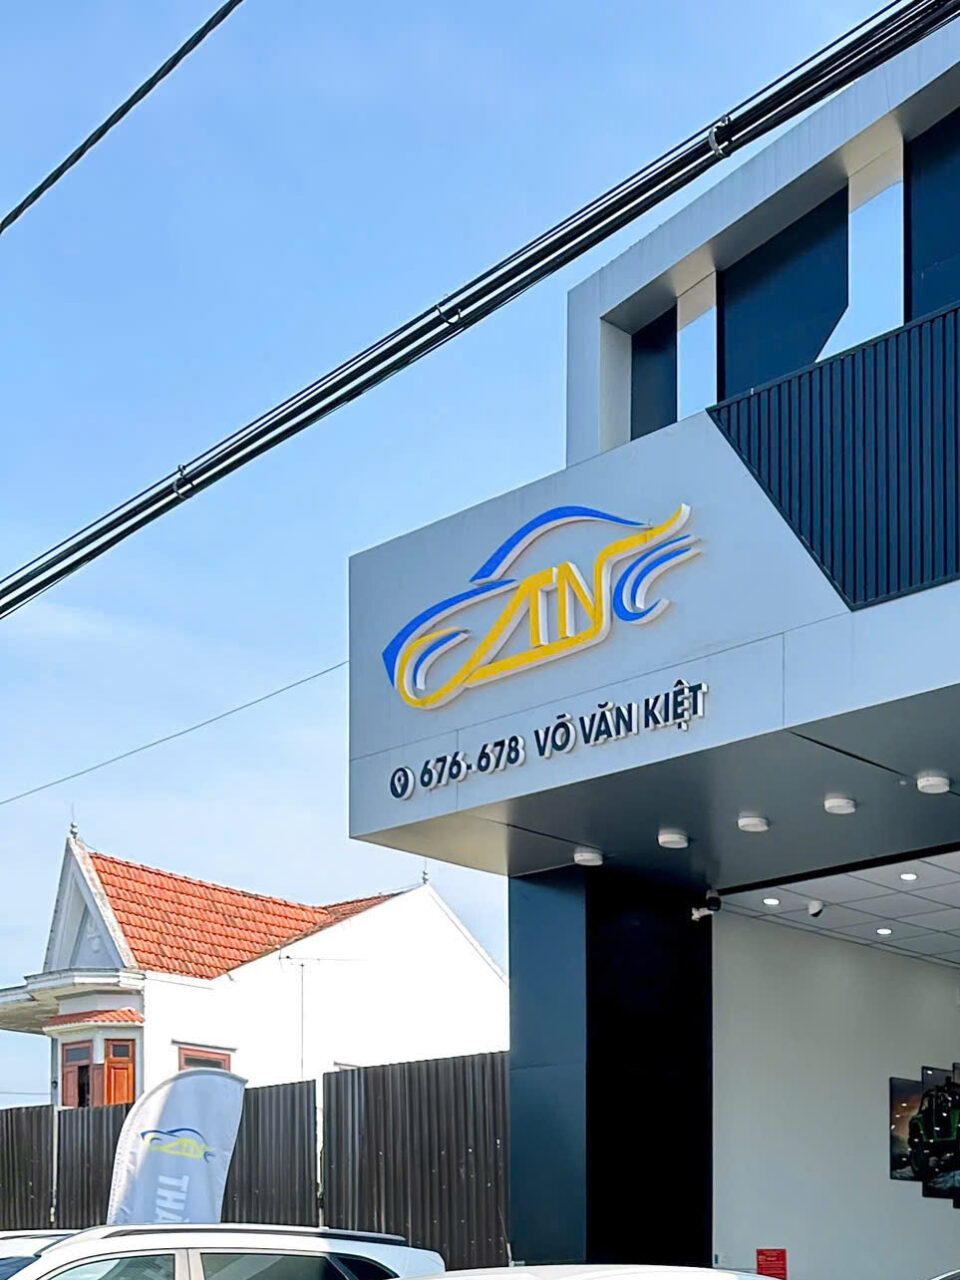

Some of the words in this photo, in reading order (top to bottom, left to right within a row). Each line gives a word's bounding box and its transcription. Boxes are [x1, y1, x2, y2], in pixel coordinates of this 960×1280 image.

[534, 713, 576, 759] VÕ
[579, 701, 638, 746] VĂN
[644, 679, 708, 731] KIỆT
